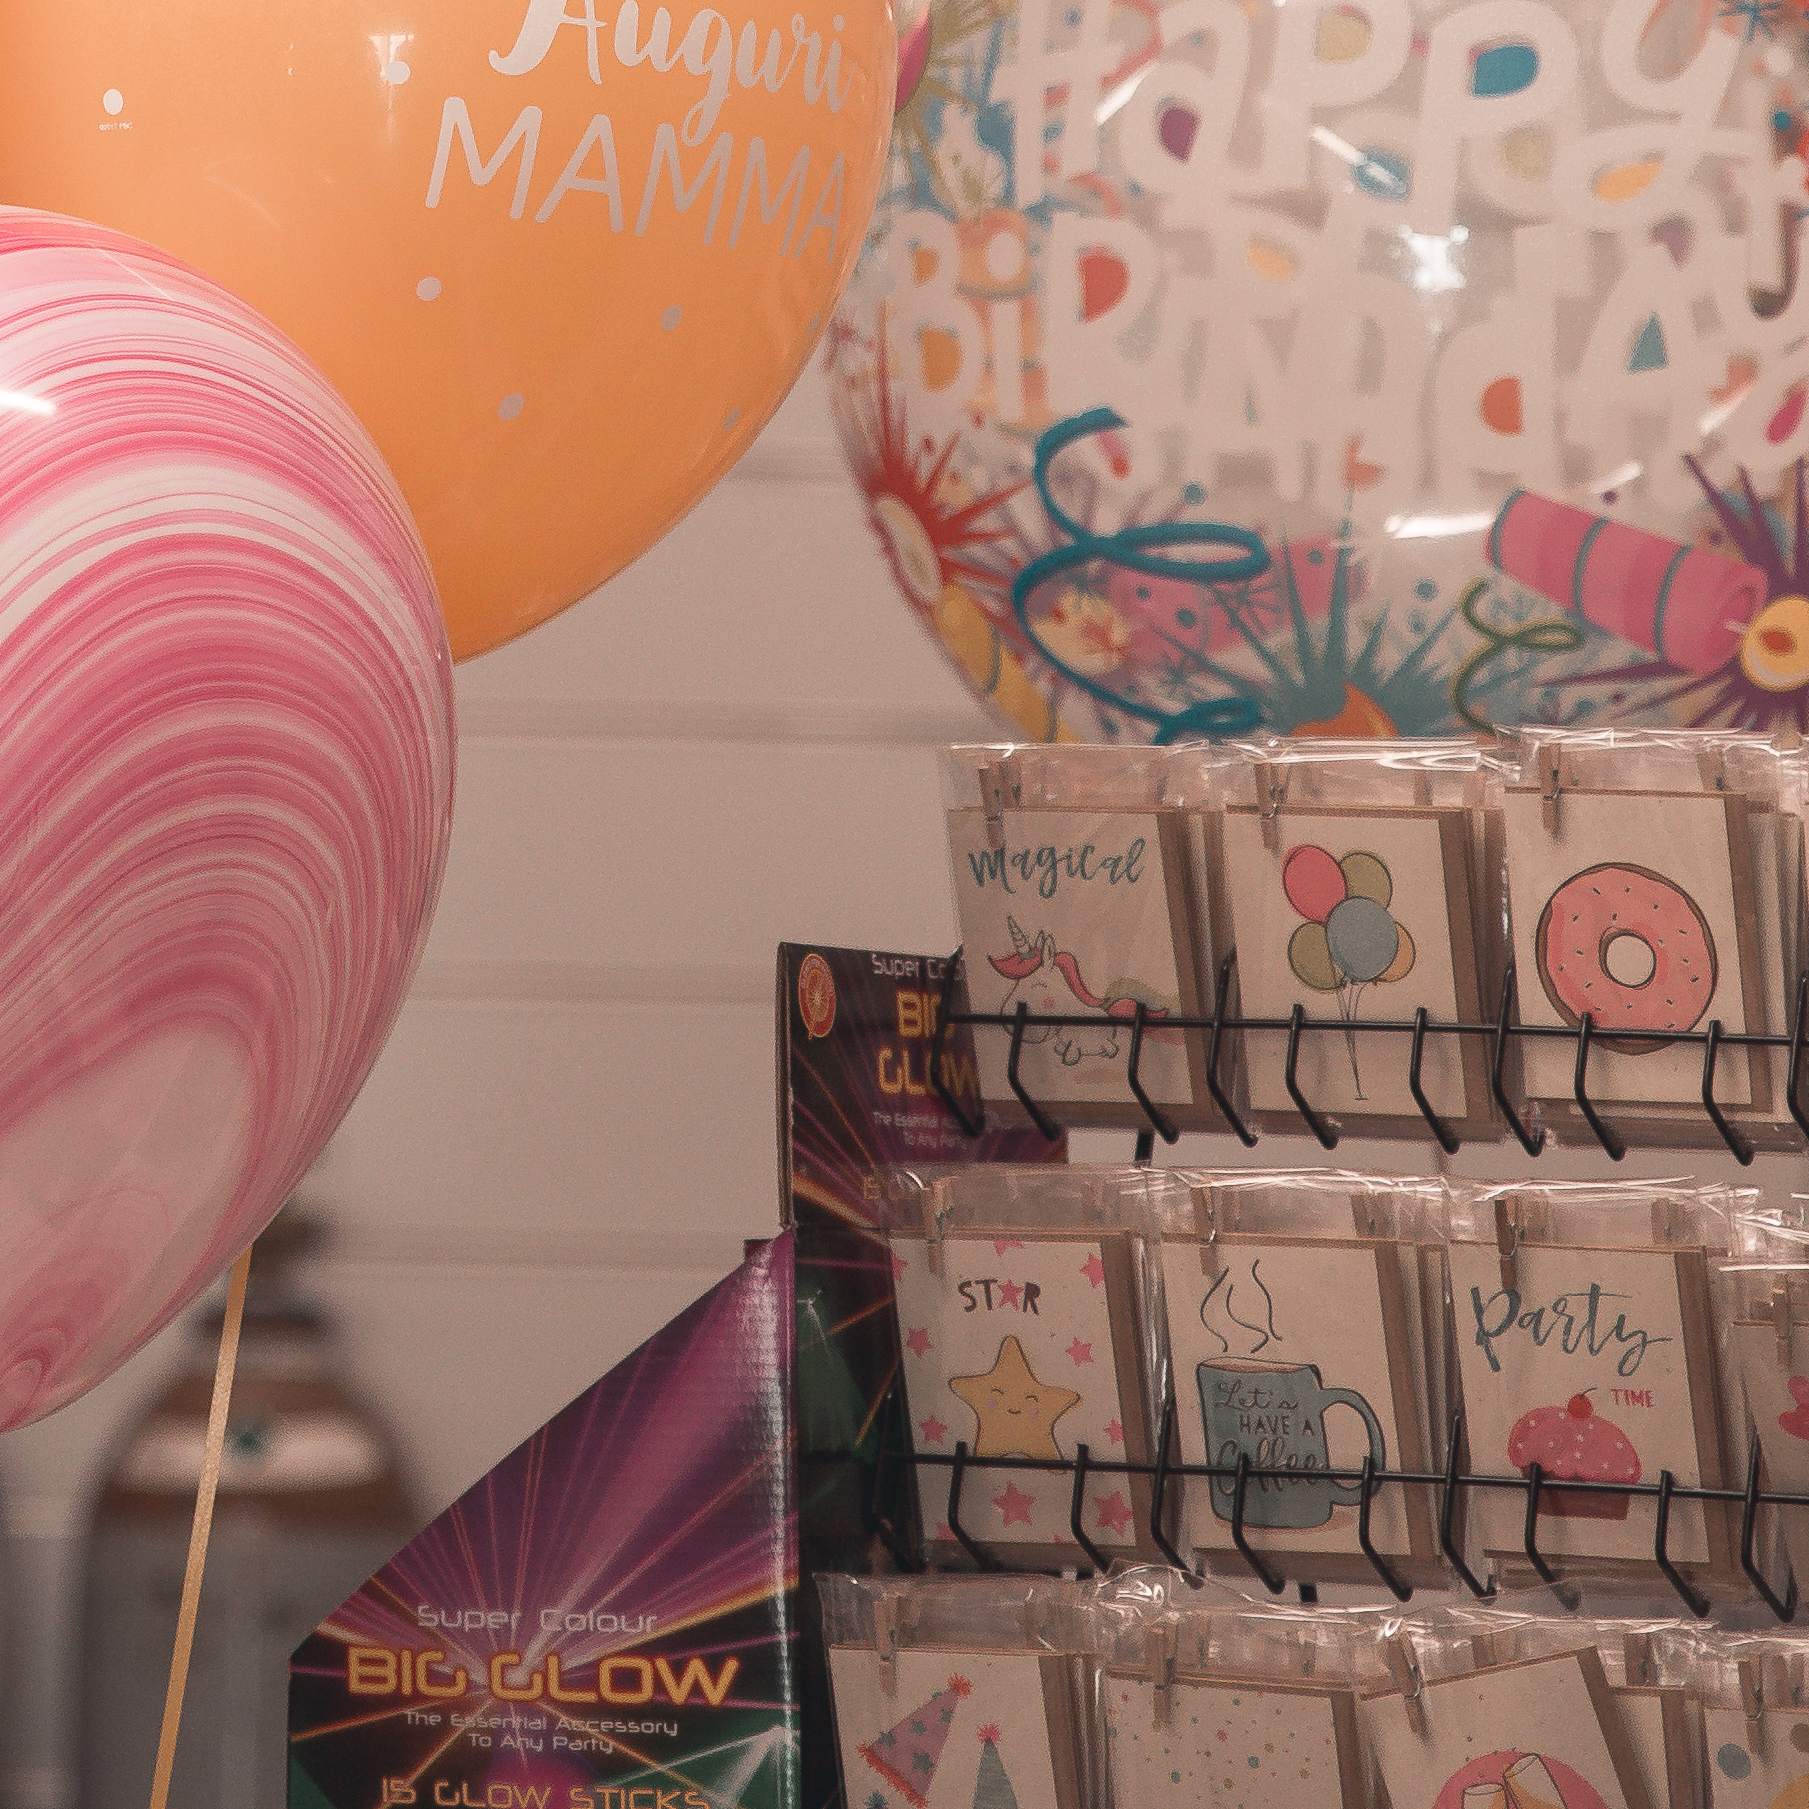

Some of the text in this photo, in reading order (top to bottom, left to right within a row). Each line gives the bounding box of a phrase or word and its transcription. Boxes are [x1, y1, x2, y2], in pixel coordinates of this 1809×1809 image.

[424, 96, 846, 266] MAMMA
[872, 953, 921, 981] Super
[1469, 1282, 1674, 1378] Party
[1213, 1378, 1300, 1412] Let's
[1610, 1387, 1657, 1409] TIME
[1240, 1414, 1316, 1437] HAVE A
[1215, 1435, 1328, 1497] Cffee
[417, 1604, 658, 1634] Super Colour
[347, 1645, 741, 1707] BIG GLOW
[405, 1709, 679, 1738] The Essential Accessory
[468, 1732, 615, 1756] To Any Party
[381, 1776, 712, 1809] 15 GLOW STICKS
